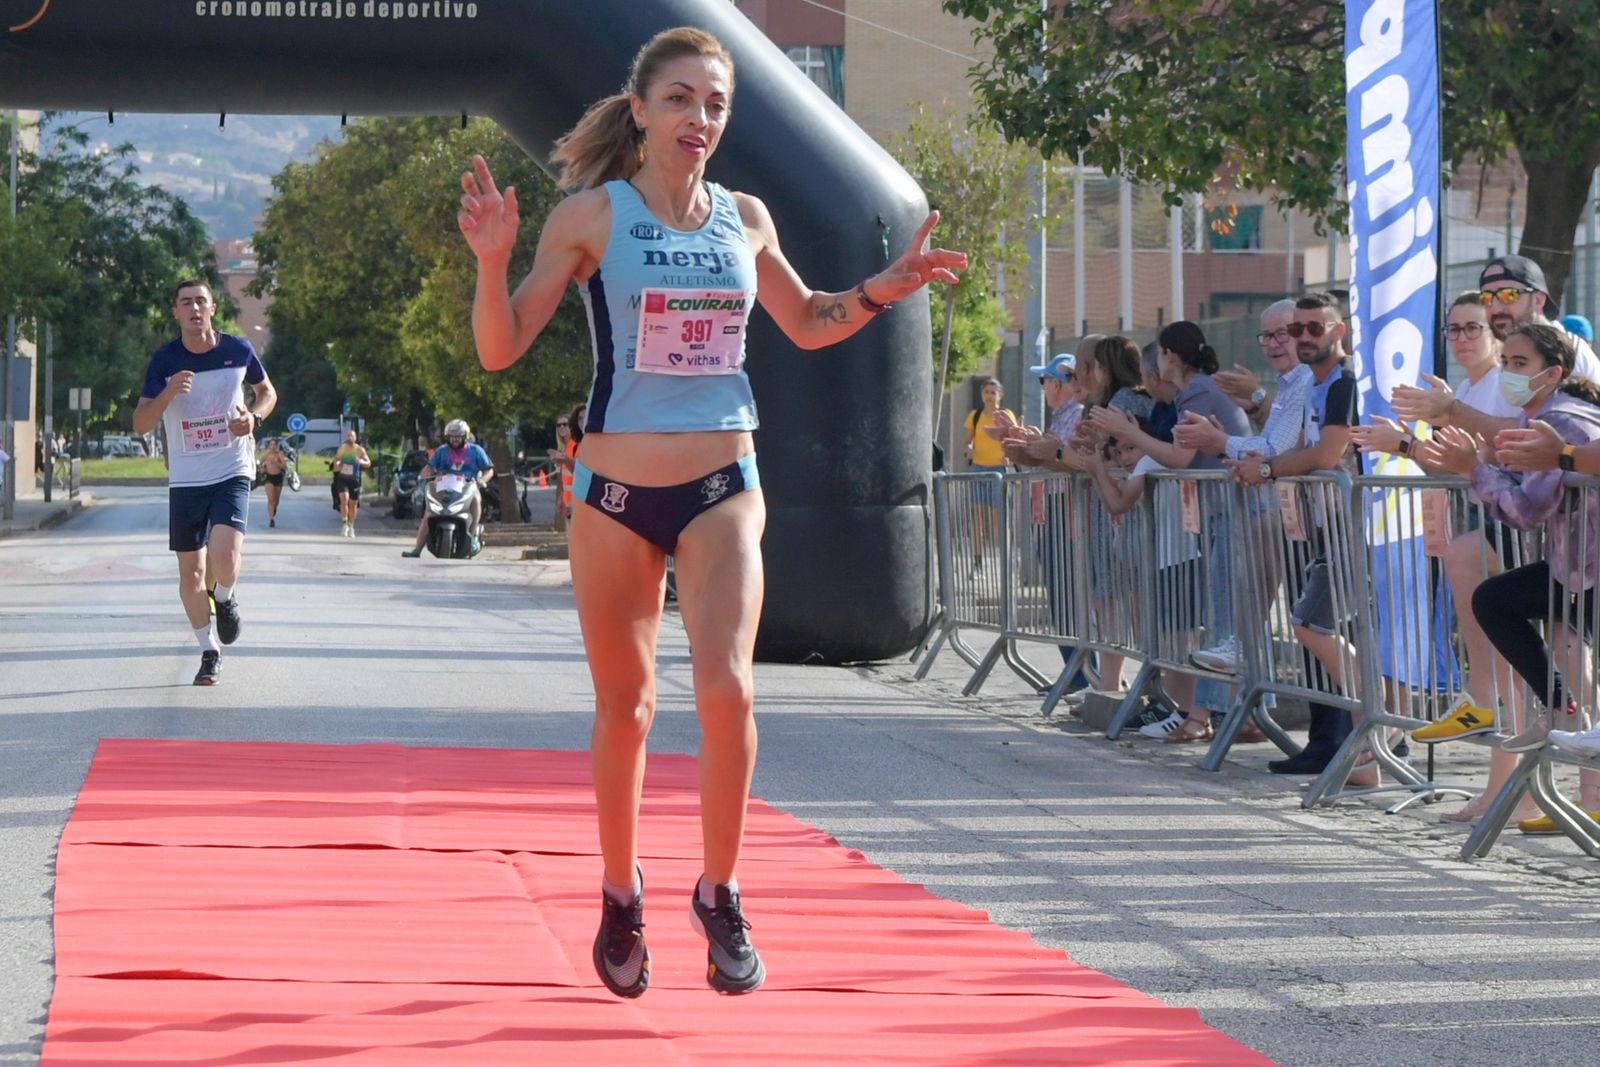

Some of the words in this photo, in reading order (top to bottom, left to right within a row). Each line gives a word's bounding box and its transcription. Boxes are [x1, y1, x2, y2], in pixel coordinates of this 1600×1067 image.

[195, 0, 357, 19] cronometraje
[363, 0, 478, 19] deportivo
[643, 247, 740, 275] nerja
[659, 275, 737, 286] ATLETISMO
[667, 298, 745, 311] COVIRAN
[681, 320, 713, 343] 397
[687, 354, 721, 366] vithas
[197, 429, 213, 439] 512
